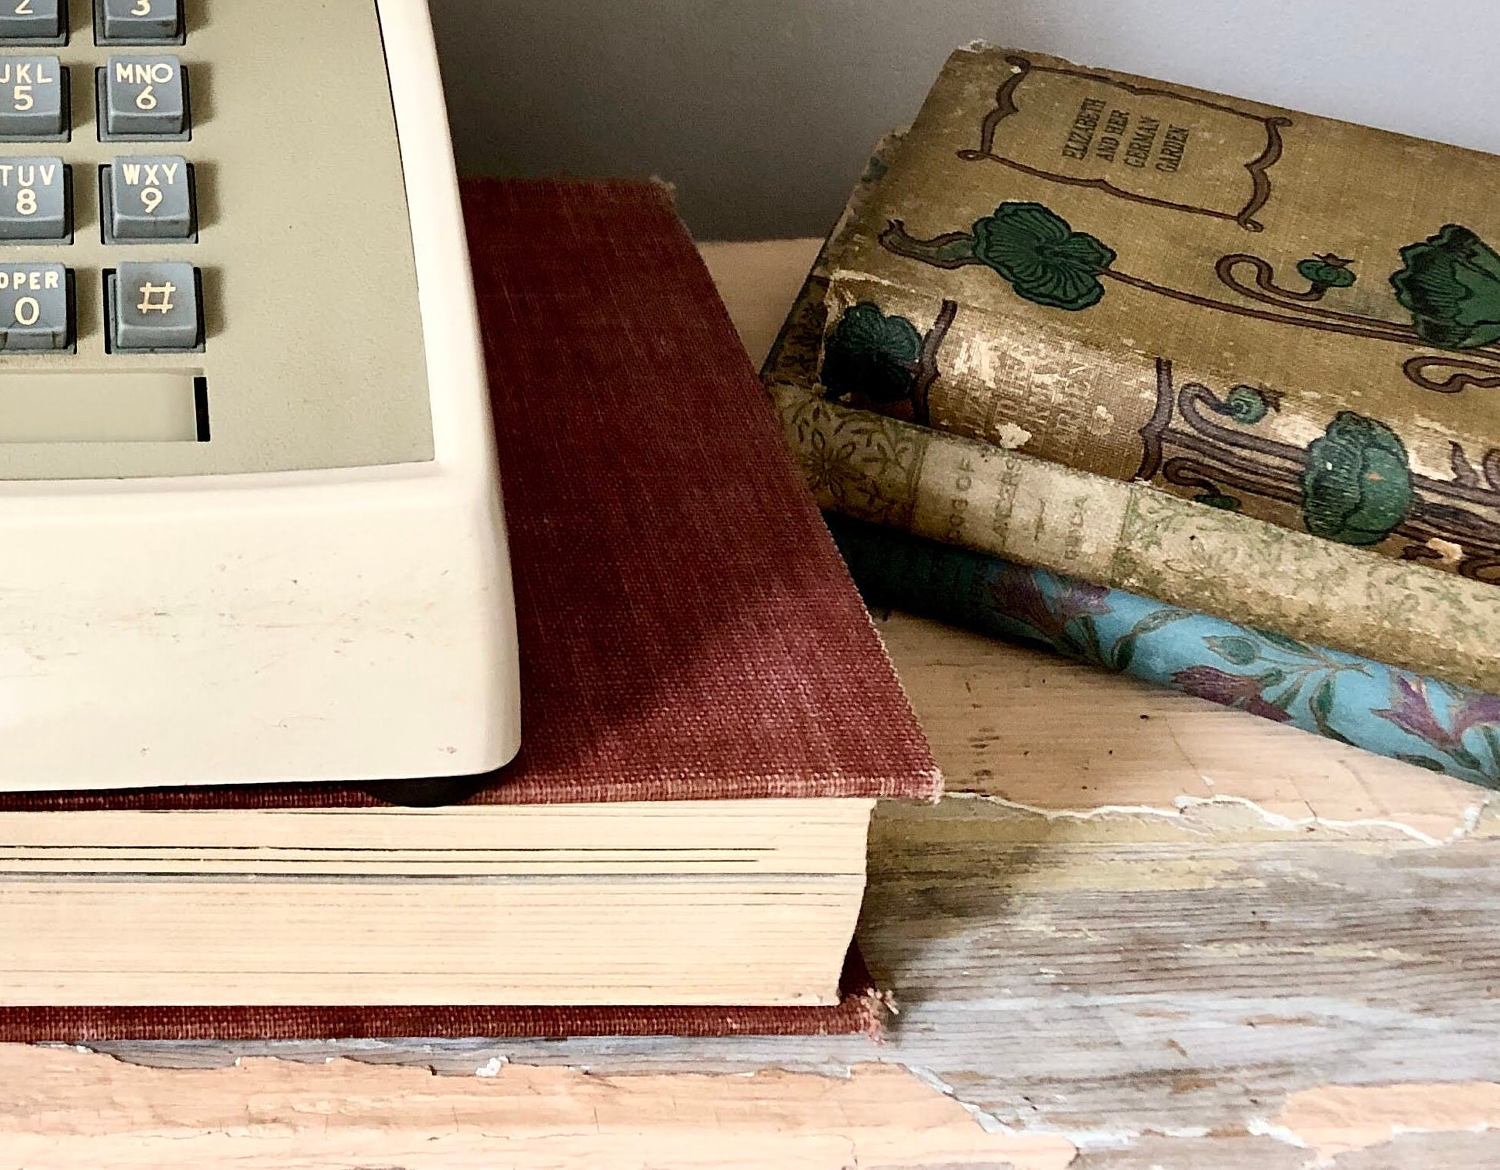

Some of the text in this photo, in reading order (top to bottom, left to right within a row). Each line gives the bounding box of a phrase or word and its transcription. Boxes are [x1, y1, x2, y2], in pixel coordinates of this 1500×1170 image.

[116, 63, 173, 82] MNO
[13, 87, 33, 111] 5
[136, 86, 157, 110] 6
[1062, 97, 1107, 160] ELIZABETH
[1096, 109, 1130, 163] AND HER
[1122, 115, 1160, 168] GERMAN
[1155, 124, 1190, 172] GARDEN
[122, 164, 177, 185] WXY
[17, 190, 37, 215] 8
[140, 188, 162, 213] 9
